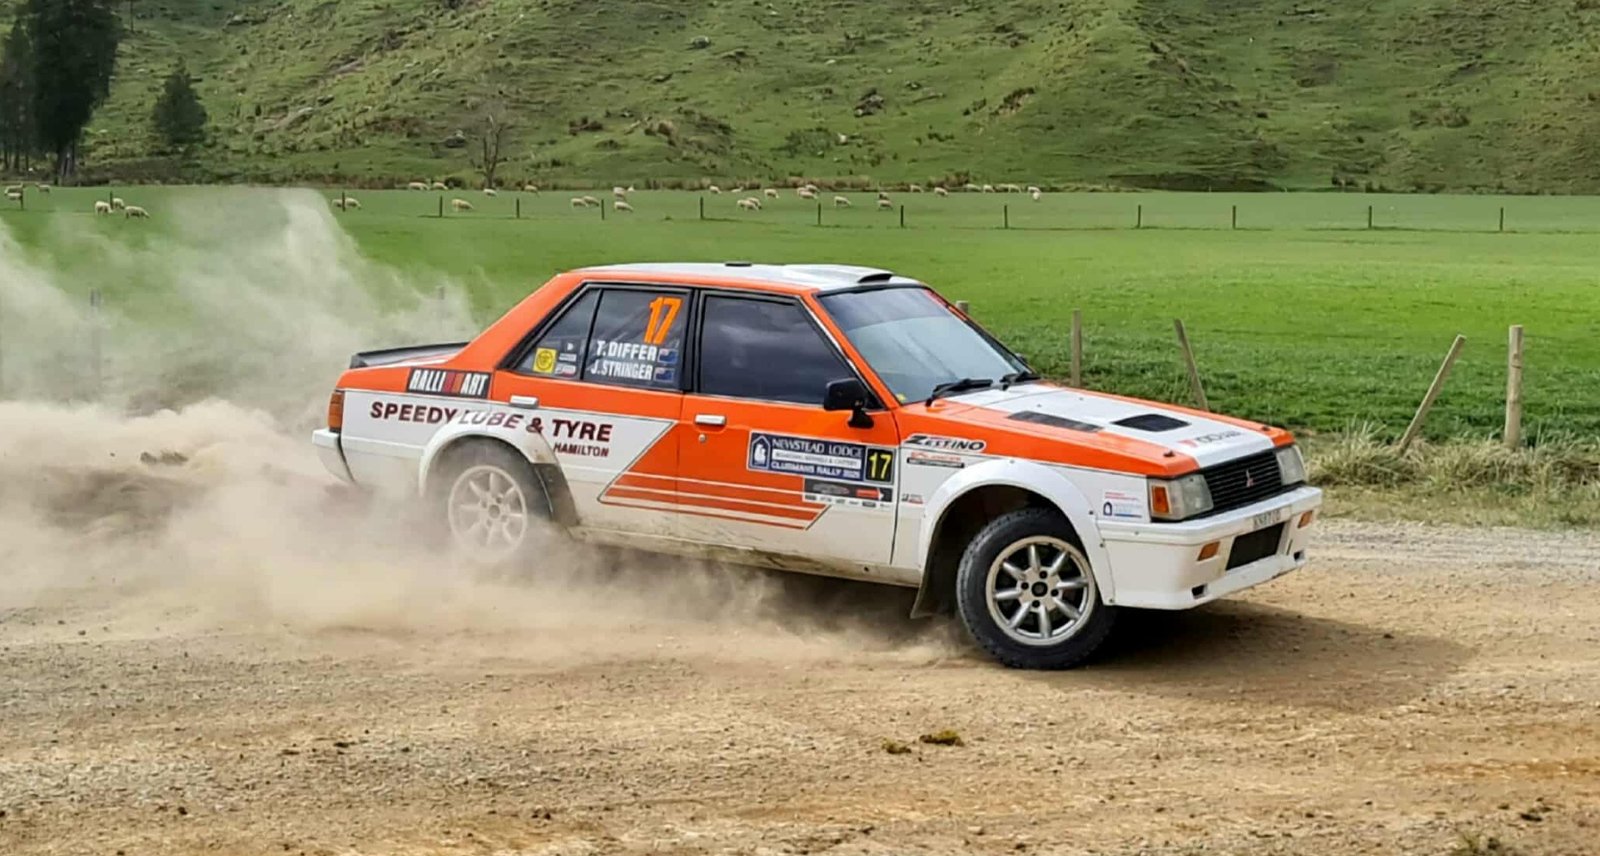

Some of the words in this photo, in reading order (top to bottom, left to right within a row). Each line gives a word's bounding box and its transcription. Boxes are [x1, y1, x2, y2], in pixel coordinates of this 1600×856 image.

[644, 296, 682, 344] 17
[591, 359, 653, 380] J.STRINGER
[370, 401, 457, 425] SPEEDY
[458, 410, 523, 429] LUBE
[526, 417, 543, 433] &
[552, 418, 612, 442] TYRE
[554, 443, 609, 457] HAMILTON
[771, 438, 825, 455] NEWSTEAD
[828, 444, 863, 458] LODGE
[816, 466, 842, 477] RALLY
[869, 452, 892, 480] 17
